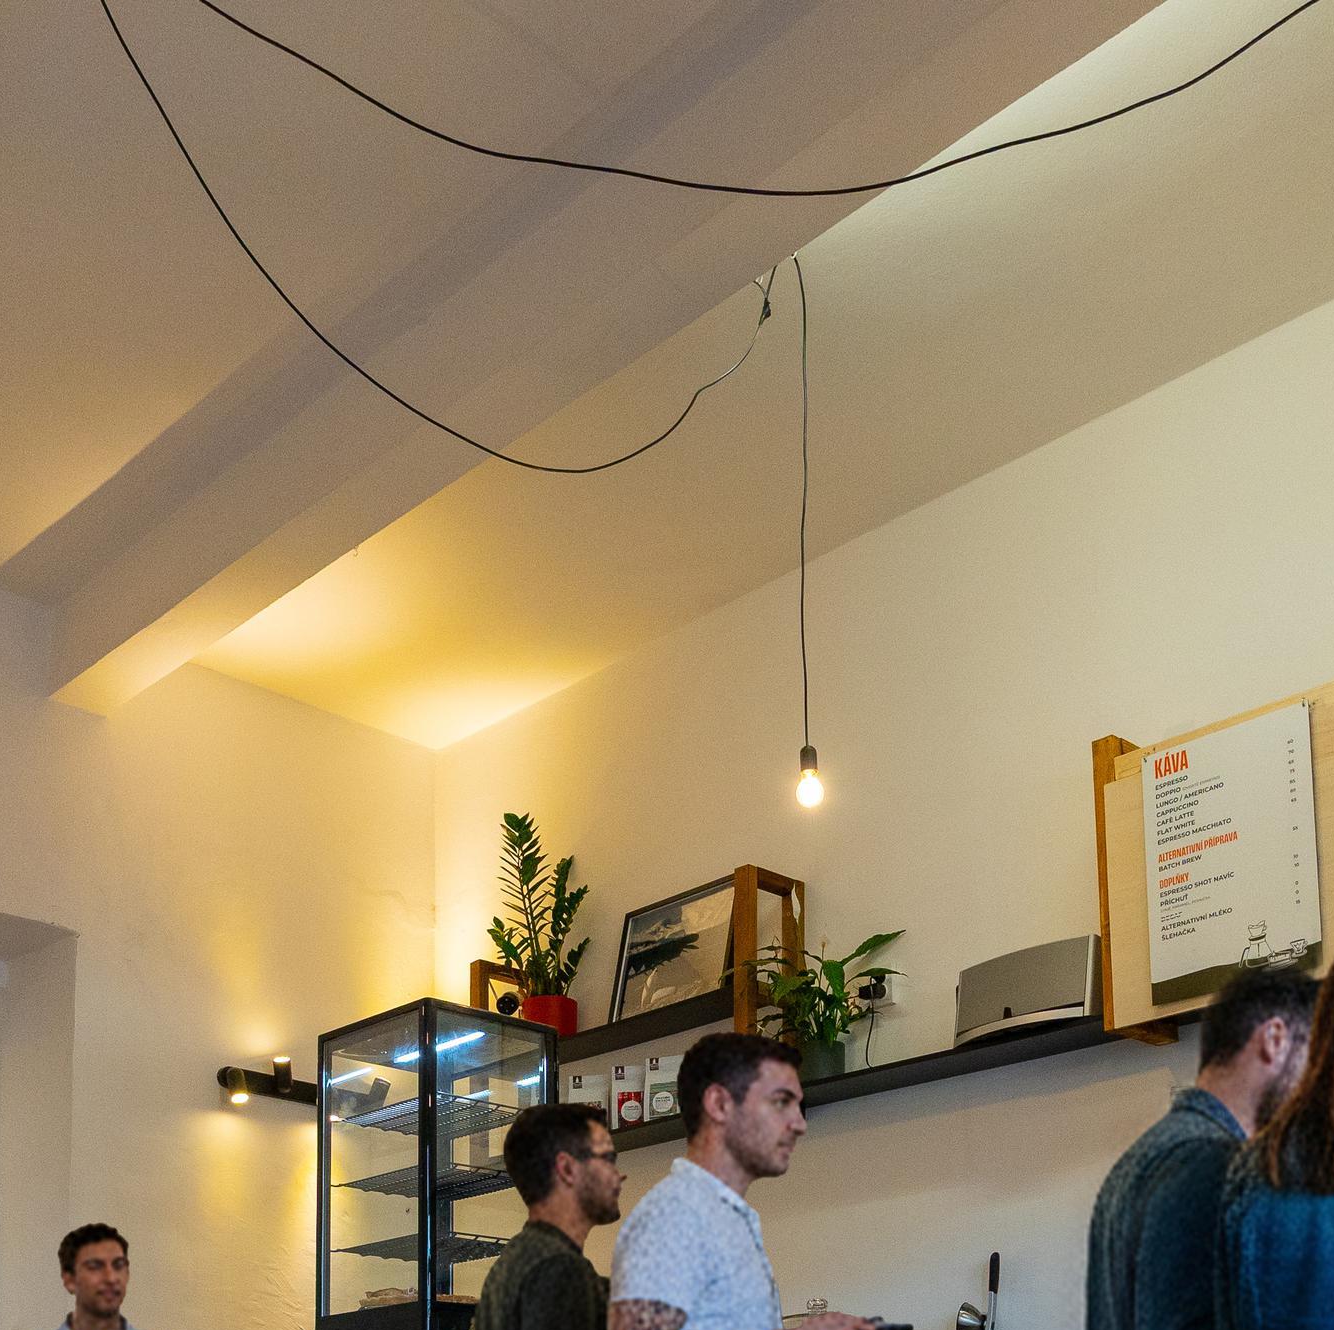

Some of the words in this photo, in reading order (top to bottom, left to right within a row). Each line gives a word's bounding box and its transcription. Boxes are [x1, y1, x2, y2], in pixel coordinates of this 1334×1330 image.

[1154, 750, 1189, 780] KÁVA
[1155, 775, 1188, 791] ESPRESSO
[1155, 787, 1181, 800] DOPPIO
[1155, 797, 1178, 809] LUNGO
[1184, 782, 1224, 801] AMERICANO
[1156, 799, 1199, 818] CAPPUCCINO
[1156, 816, 1173, 827] CAFÉ
[1174, 810, 1195, 822] LATTE
[1157, 825, 1173, 836] FLAT
[1173, 820, 1196, 833] WHITE
[1157, 830, 1191, 846] ESPRESSO
[1192, 817, 1232, 835] MACCHIATO
[1158, 841, 1203, 864] ALTERNATIVNÍ
[1203, 831, 1238, 850] PŘÍPRAVA
[1158, 861, 1180, 872] BATCH
[1181, 854, 1202, 866] BREW
[1160, 883, 1193, 898] ESPRESSO
[1194, 877, 1212, 889] SHOT
[1213, 871, 1235, 883] NAVÍC
[1161, 913, 1208, 932] ALTERNATIVNÍ
[1208, 907, 1233, 921] MLÉKO
